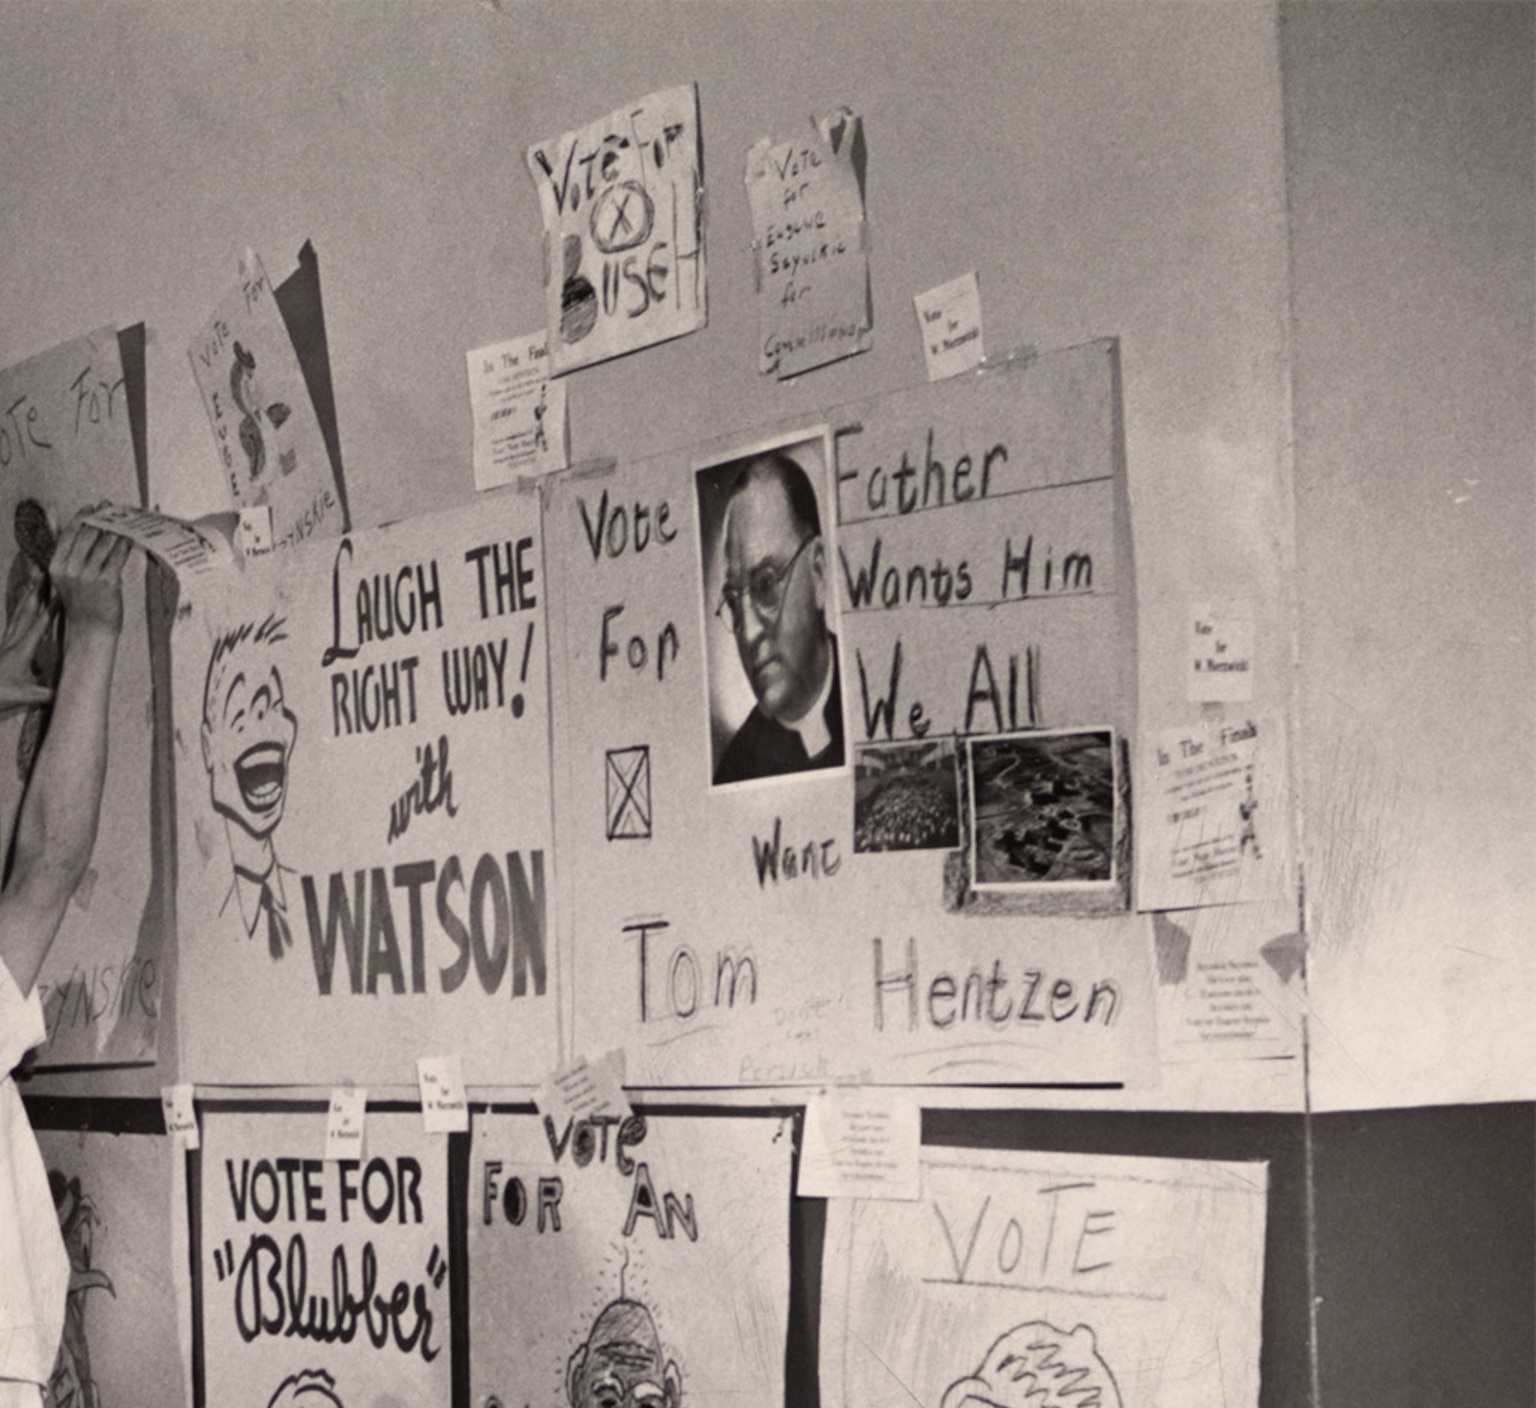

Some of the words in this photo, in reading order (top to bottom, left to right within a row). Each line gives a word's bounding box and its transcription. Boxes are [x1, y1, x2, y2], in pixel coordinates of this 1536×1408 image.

[834, 421, 1010, 516] Father
[321, 538, 444, 668] LAUGH
[464, 536, 538, 621] THE
[836, 537, 974, 610] Wants
[1001, 534, 1095, 596] Him
[330, 655, 420, 738] RIGHT
[440, 621, 536, 720] WAY!
[387, 734, 461, 845] with
[299, 848, 548, 1000] WATSON
[621, 918, 758, 1023] Tom
[871, 936, 1124, 1033] Hentzen
[225, 1157, 327, 1225] VOTE
[338, 1156, 425, 1225] FOR
[483, 1160, 565, 1235] FOR
[621, 1162, 699, 1242] AN
[931, 1181, 1117, 1285] VOTE
